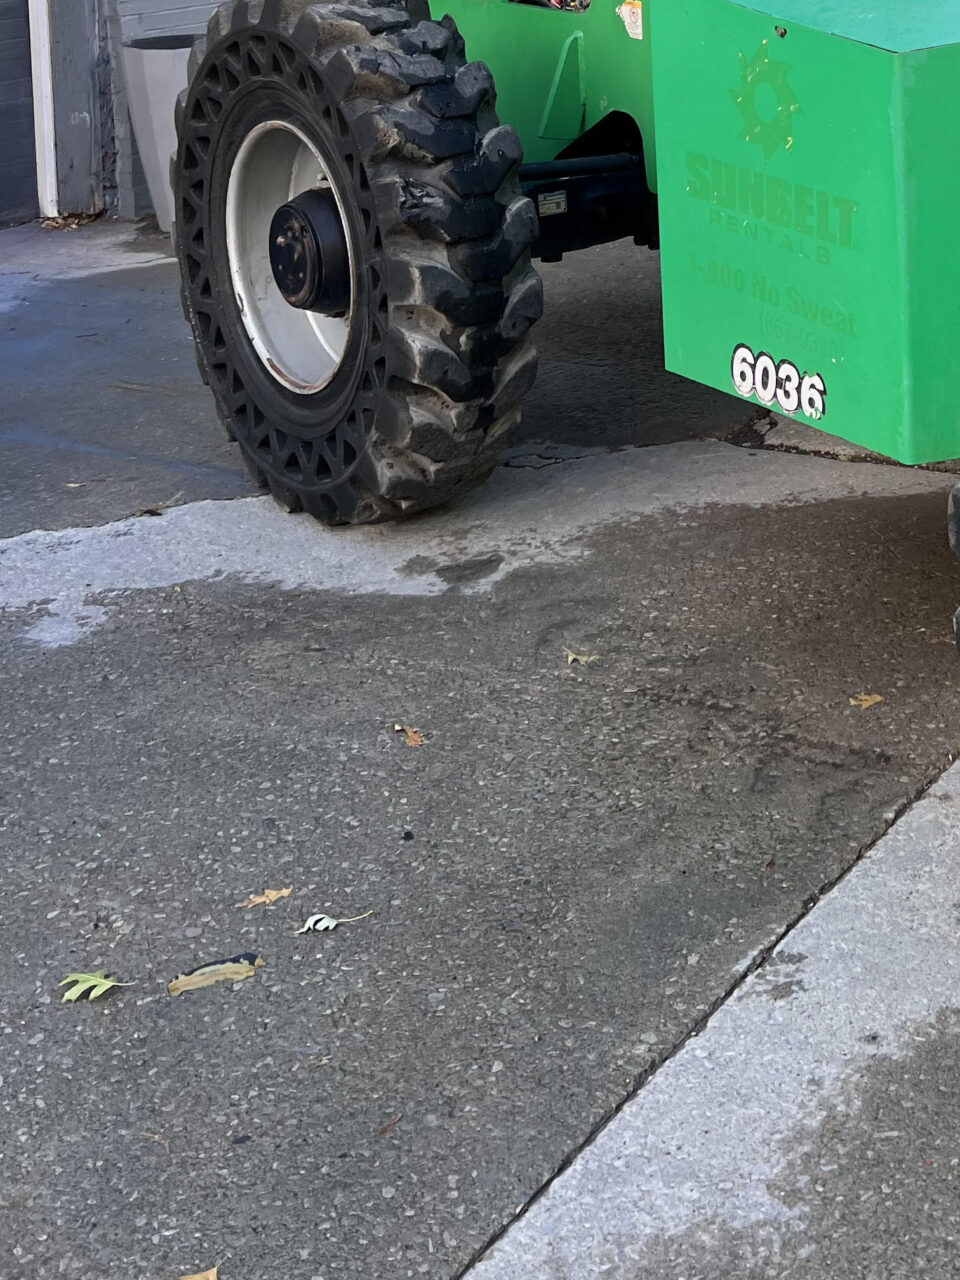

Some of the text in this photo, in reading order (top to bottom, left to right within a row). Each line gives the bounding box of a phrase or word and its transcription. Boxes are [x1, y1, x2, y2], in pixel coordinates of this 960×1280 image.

[686, 151, 858, 250] SUNBELT
[709, 208, 831, 267] RENTALS
[731, 343, 828, 420] 6036
